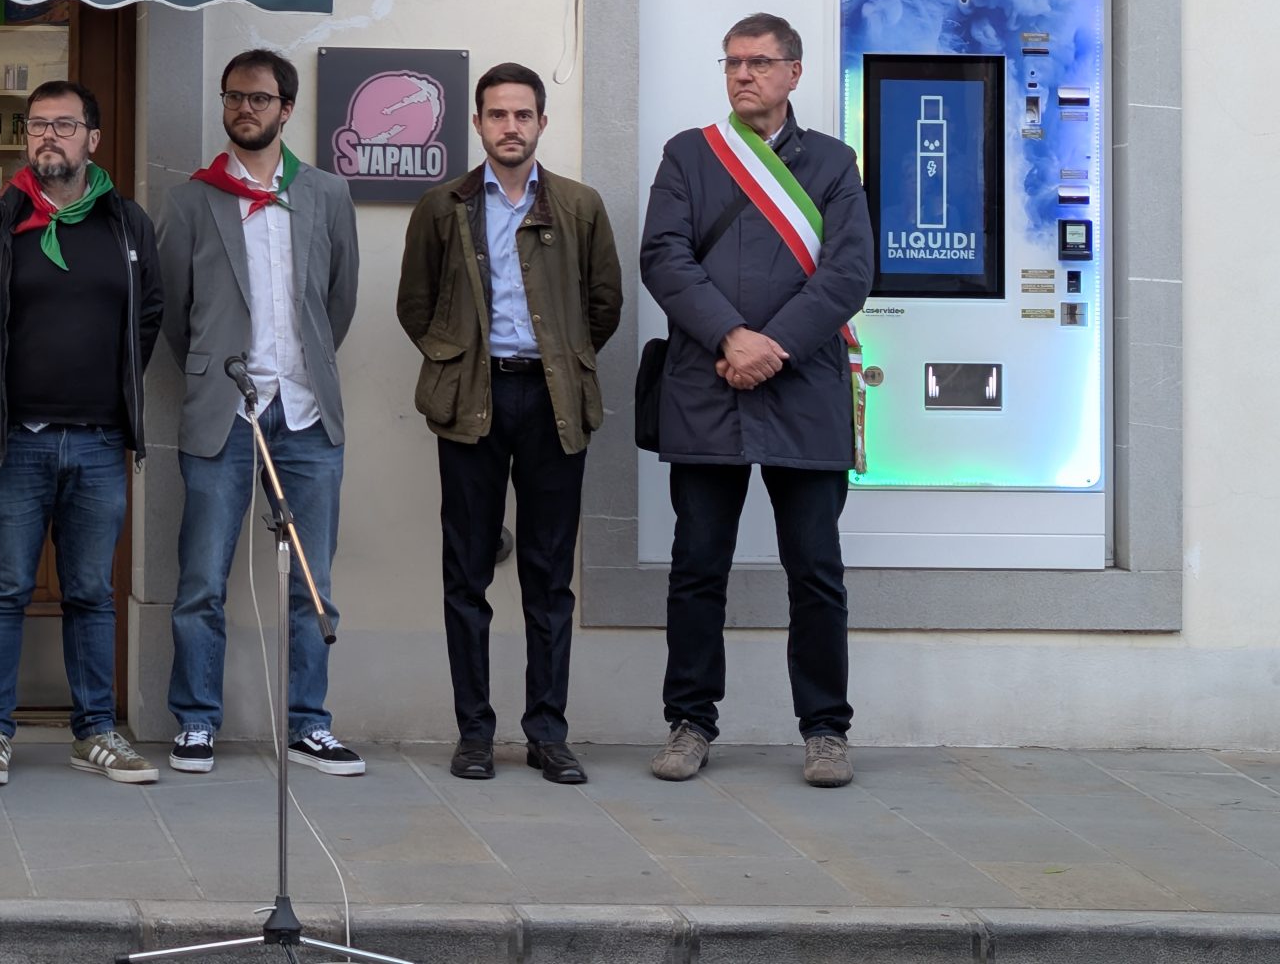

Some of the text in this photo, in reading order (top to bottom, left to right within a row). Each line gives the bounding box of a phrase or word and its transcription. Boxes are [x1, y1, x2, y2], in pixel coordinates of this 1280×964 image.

[336, 129, 442, 177] SVAPALO
[887, 231, 976, 249] LIQUIDI
[887, 248, 976, 260] DA INALAZIONE
